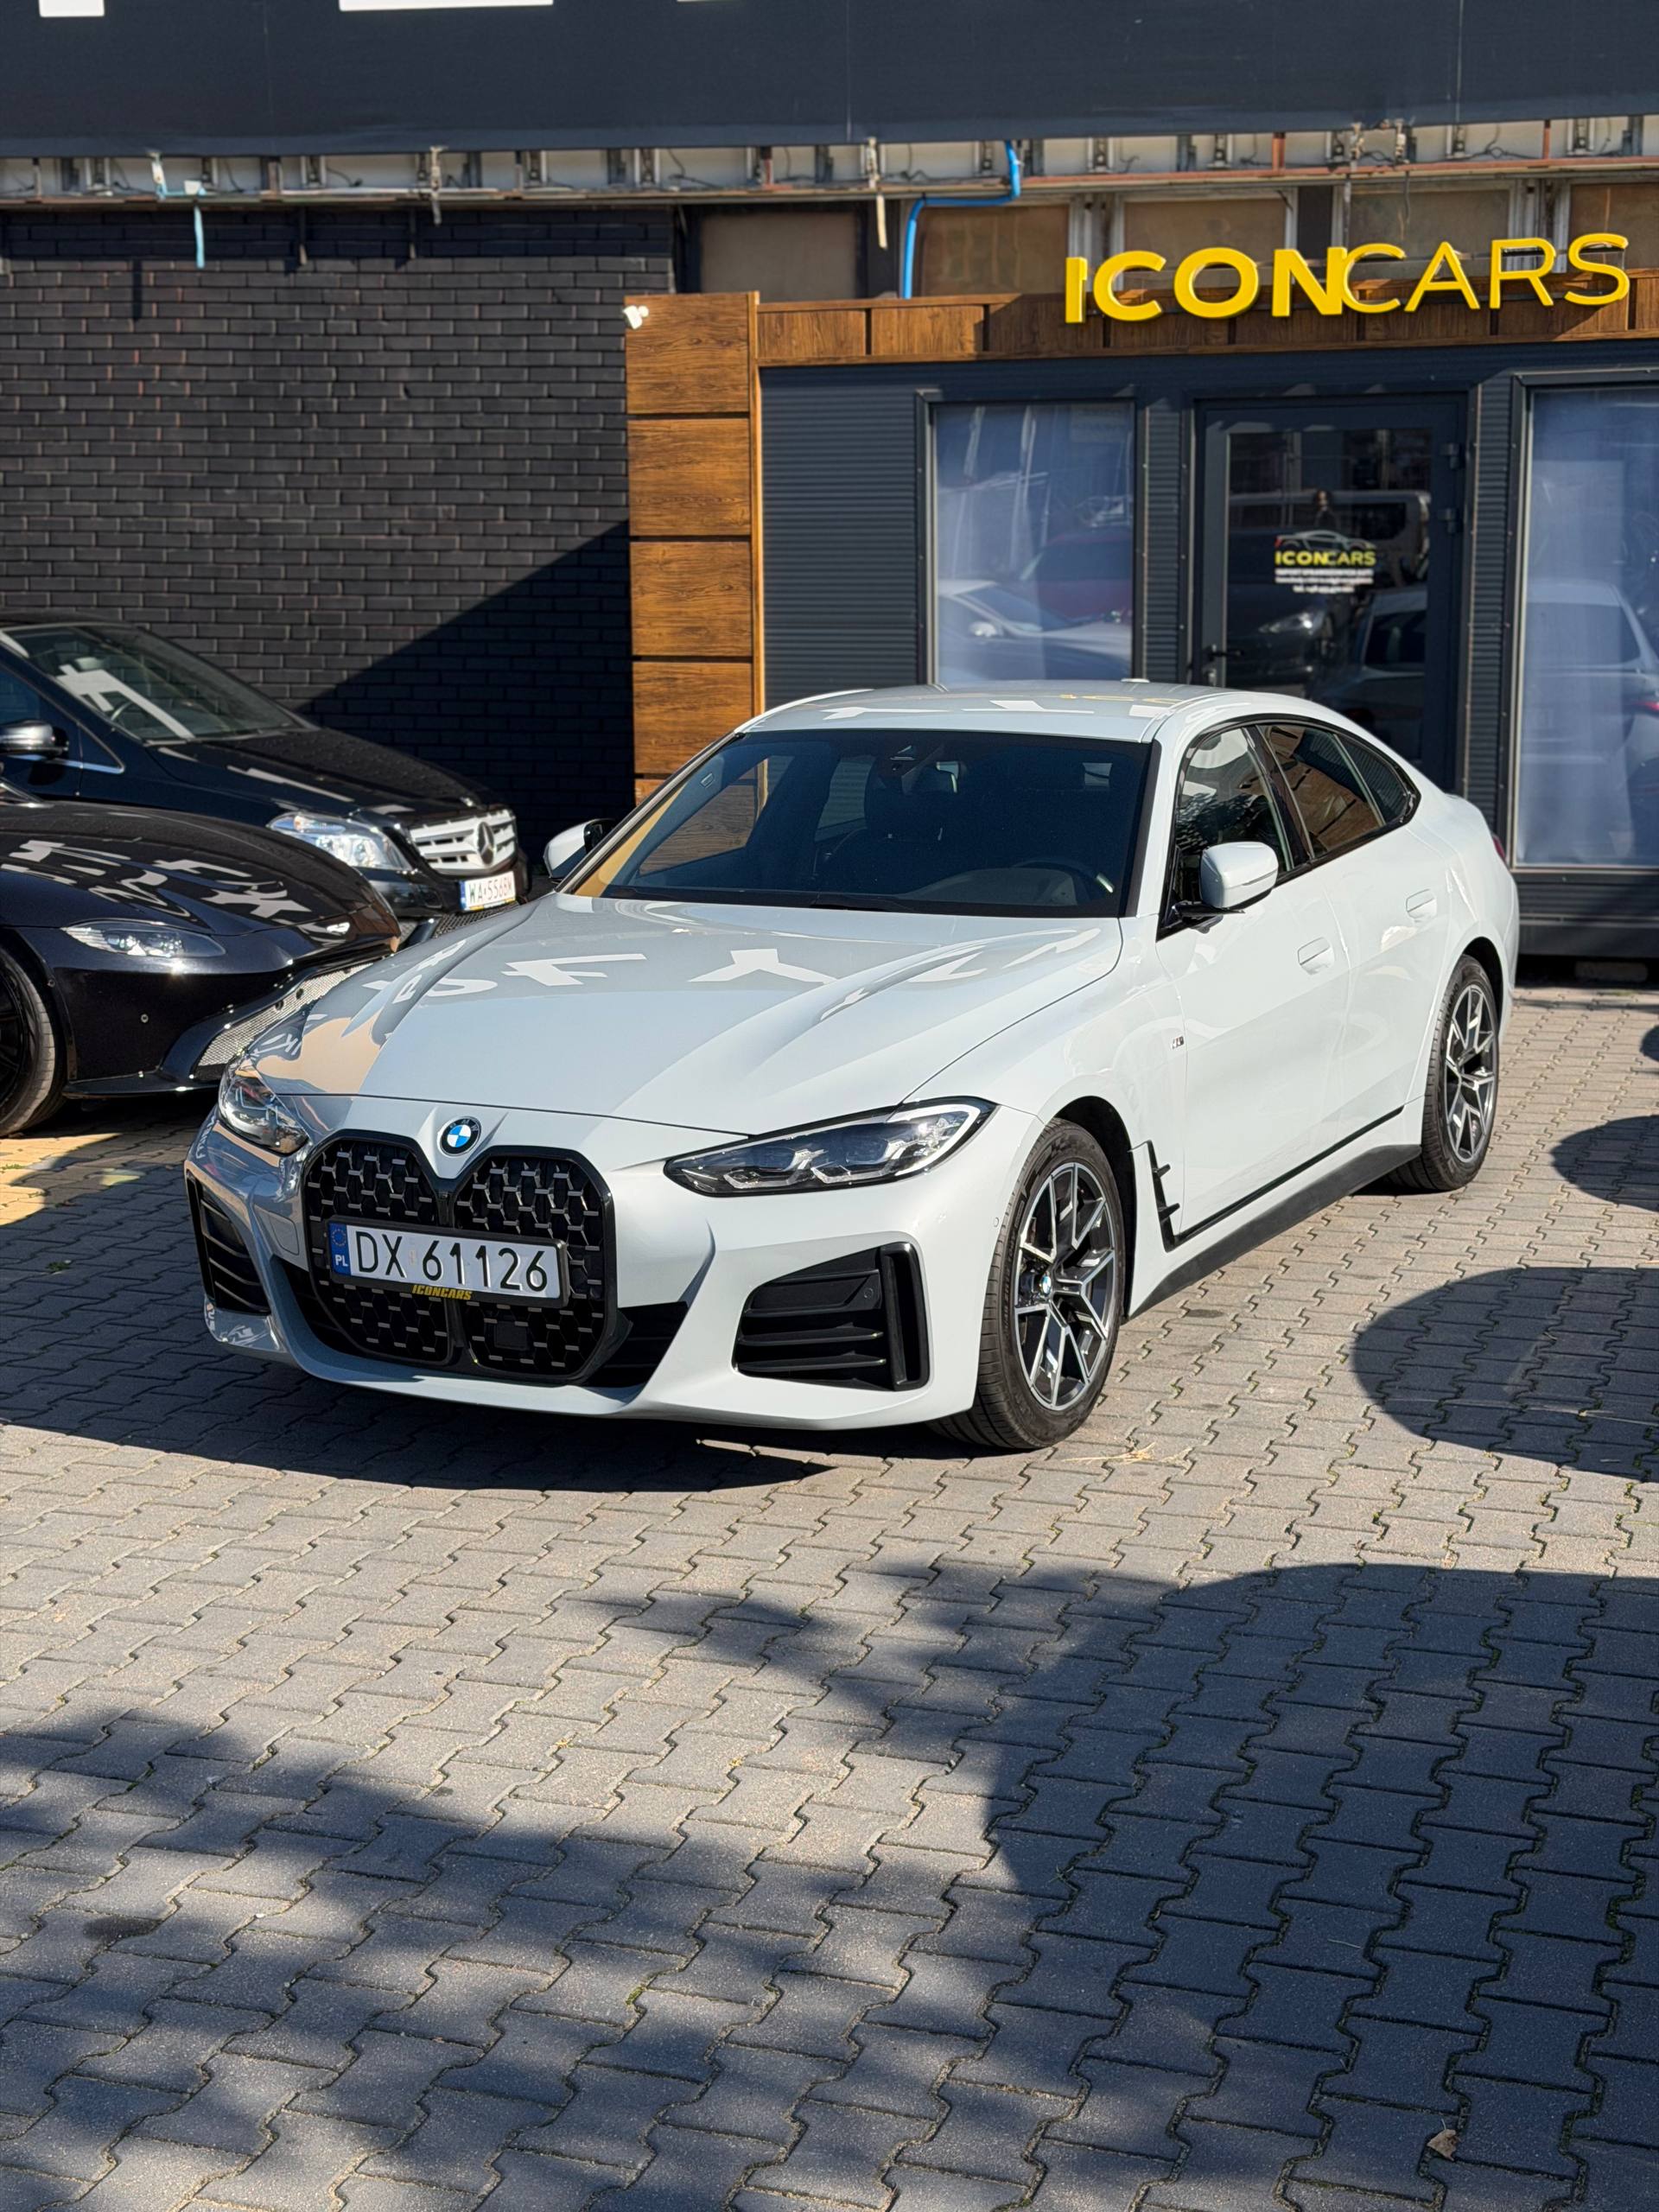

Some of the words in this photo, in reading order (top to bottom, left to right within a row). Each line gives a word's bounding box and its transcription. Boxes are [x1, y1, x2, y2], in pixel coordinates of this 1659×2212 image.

[1065, 233, 1630, 324] ICONCARS
[1274, 550, 1376, 566] ICONCARS
[334, 1254, 348, 1267] PL
[355, 1230, 406, 1278] DX
[423, 1240, 548, 1293] 61126
[411, 1284, 473, 1300] ICONCARS
